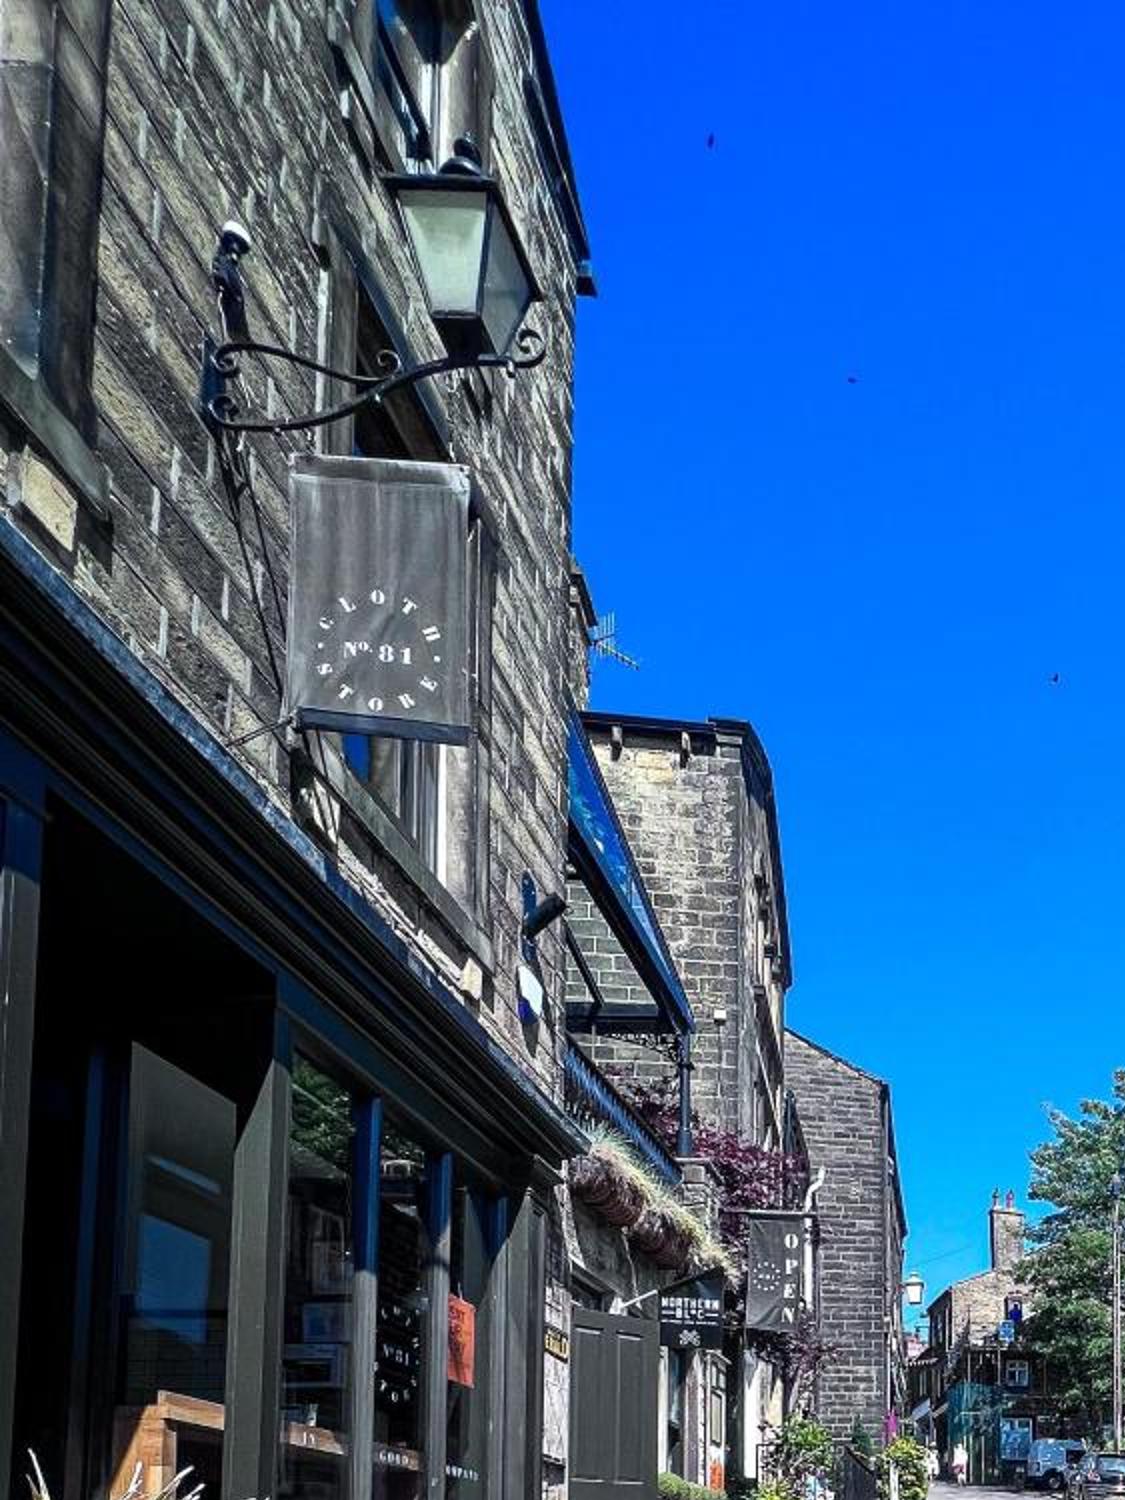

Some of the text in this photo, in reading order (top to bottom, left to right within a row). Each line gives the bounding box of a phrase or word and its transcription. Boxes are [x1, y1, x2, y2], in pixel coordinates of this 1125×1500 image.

[379, 644, 412, 665] 81
[781, 1233, 799, 1324] OPEN
[661, 1296, 720, 1311] NORTHERN
